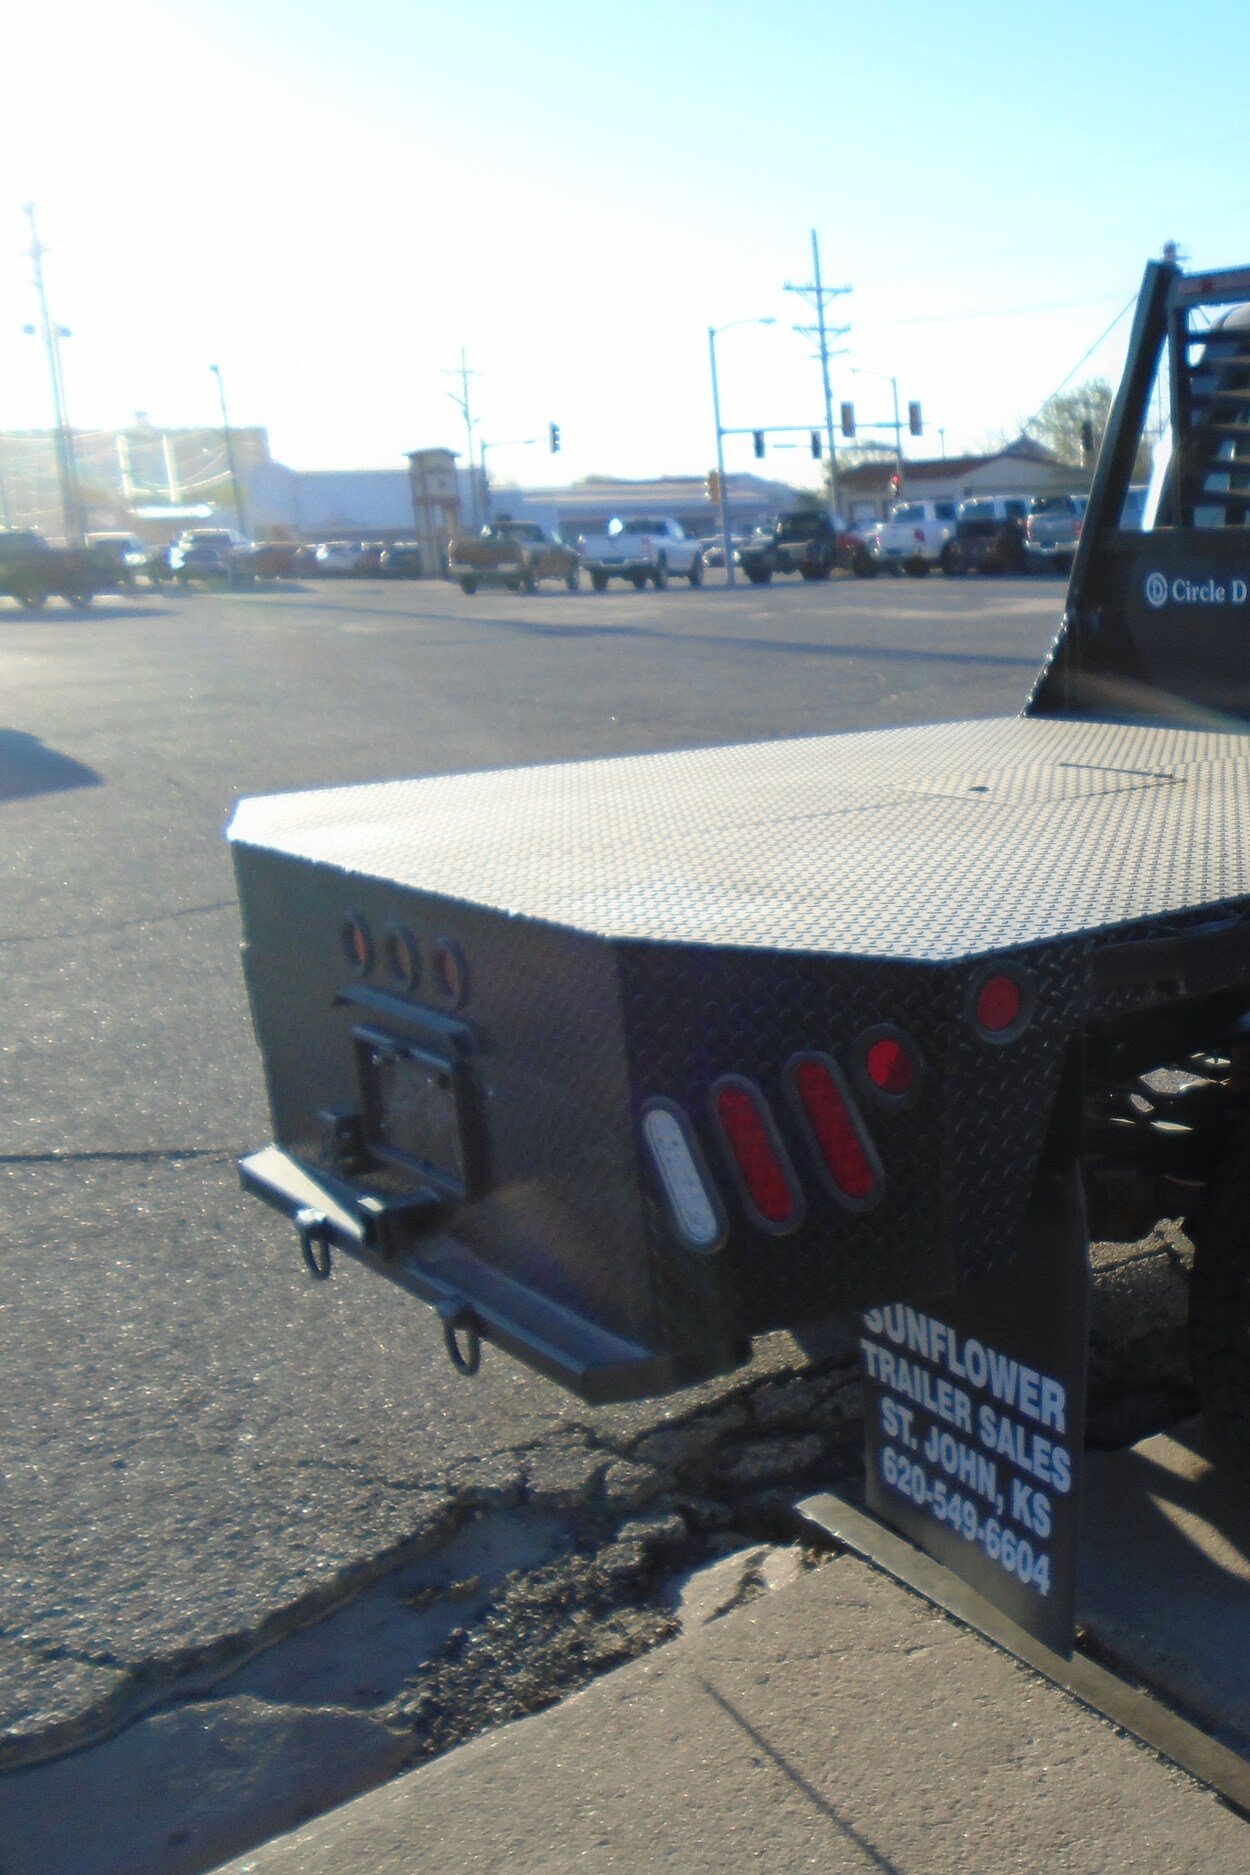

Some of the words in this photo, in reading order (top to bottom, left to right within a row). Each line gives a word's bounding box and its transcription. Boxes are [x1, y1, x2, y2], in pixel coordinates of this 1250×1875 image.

[1172, 578, 1225, 602] Circle
[1232, 579, 1247, 602] D
[860, 1338, 972, 1434] TRAILER
[979, 1405, 1071, 1493] SALES
[882, 1397, 918, 1450] ST.
[924, 1426, 1004, 1515] JOHN,
[1012, 1478, 1052, 1538] KS
[882, 1447, 1050, 1596] 620-549-6604
